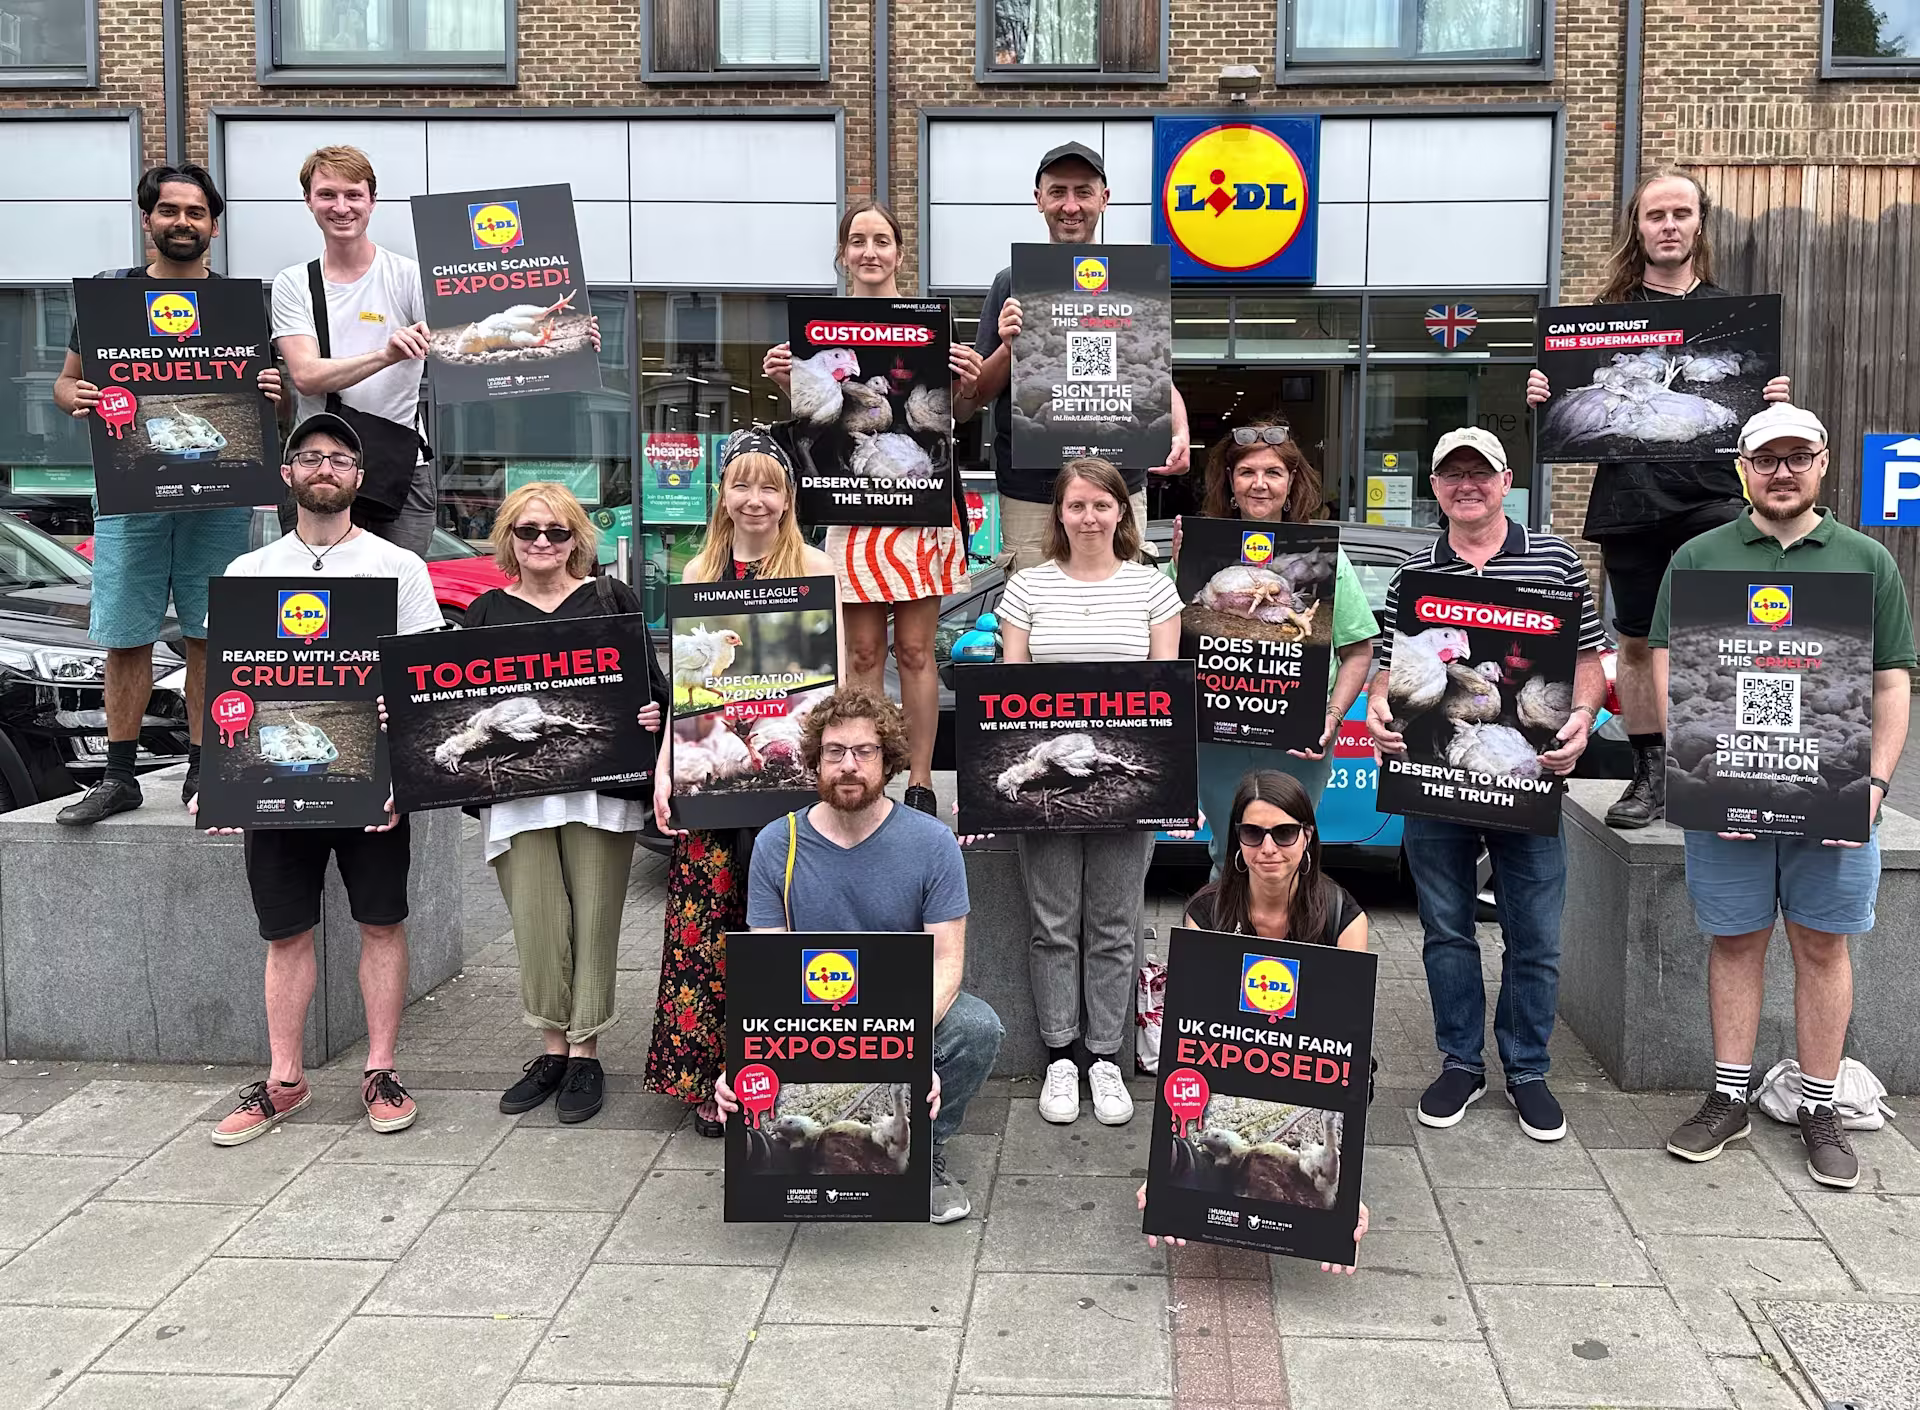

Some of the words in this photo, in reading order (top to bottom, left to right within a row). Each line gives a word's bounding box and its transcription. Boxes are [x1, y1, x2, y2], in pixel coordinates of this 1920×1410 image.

[432, 261, 497, 276] CHICKEN
[501, 255, 568, 270] SCANDAL
[436, 268, 570, 296] EXPOSED!
[1052, 304, 1094, 316] HELP
[1098, 304, 1132, 316] END
[1051, 318, 1078, 326] THIS
[1080, 317, 1132, 328] CRUELTY
[1548, 324, 1575, 334] CAN
[1578, 322, 1605, 333] YOU
[1608, 320, 1648, 332] TRUST
[811, 326, 929, 342] CUSTOMERS
[1548, 338, 1576, 348] THIS
[1580, 332, 1682, 346] SUPERMARKET?
[97, 348, 163, 359] REARED
[167, 347, 209, 358] WITH
[213, 345, 257, 358] CARE
[109, 360, 248, 382] CRUELTY
[1052, 384, 1092, 397] SIGN
[1098, 384, 1132, 397] THE
[1052, 398, 1132, 412] PETITION
[644, 444, 704, 460] cheapest
[802, 476, 868, 488] DESERVE
[872, 478, 892, 488] TO
[896, 478, 944, 490] KNOW
[1883, 462, 1920, 520] P
[832, 493, 862, 504] THE
[864, 494, 913, 505] TRUTH
[700, 590, 750, 601] HUMANE
[753, 587, 798, 598] LEAGUE
[1421, 602, 1554, 630] CUSTOMERS
[1200, 635, 1253, 654] DOES
[1258, 640, 1303, 658] THIS
[1719, 639, 1772, 654] HELP
[1778, 640, 1823, 656] END
[222, 651, 288, 662] REARED
[292, 650, 334, 661] WITH
[339, 650, 380, 662] CARE
[1718, 655, 1752, 666] THIS
[1756, 656, 1822, 669] CRUELTY
[408, 647, 622, 690] TOGETHER
[1198, 654, 1253, 673] LOOK
[1258, 658, 1302, 677] LIKE
[232, 666, 372, 686] CRUELTY
[705, 672, 804, 688] EXPECTATION
[410, 693, 430, 704] WE
[433, 690, 464, 702] HAVE
[465, 688, 488, 698] THE
[490, 684, 532, 696] POWER
[533, 681, 550, 691] TO
[551, 676, 596, 688] CHANGE
[598, 674, 624, 684] THIS
[722, 688, 788, 700] versus
[726, 704, 784, 716] REALITY
[979, 691, 1172, 718] TOGETHER
[1204, 693, 1230, 710] TO
[1236, 696, 1288, 715] YOU?
[980, 722, 997, 730] WE
[1000, 722, 1026, 730] HAVE
[1029, 721, 1048, 730] THE
[1050, 720, 1088, 730] POWER
[1090, 720, 1104, 728] TO
[1106, 719, 1148, 728] CHANGE
[1150, 718, 1172, 727] THIS
[1716, 734, 1768, 751] SIGN
[1775, 737, 1819, 753] THE
[1716, 750, 1818, 771] PETITION
[594, 774, 622, 782] HUMANE
[623, 770, 647, 779] LEAGUE
[1389, 760, 1464, 782] DESERVE
[1469, 771, 1492, 784] TO
[1496, 774, 1553, 794] KNOW
[1716, 770, 1818, 784] thl.link/LidlSellsSuffering
[1422, 782, 1454, 798] THE
[1458, 787, 1514, 807] TRUTH
[742, 1018, 769, 1032] UK
[774, 1018, 856, 1032] CHICKEN
[863, 1018, 914, 1032] FARM
[1178, 1018, 1204, 1036] UK
[1209, 1022, 1293, 1048] CHICKEN
[1298, 1036, 1352, 1056] FARM
[744, 1036, 914, 1060] EXPOSED!
[1178, 1038, 1350, 1086] EXPOSED!
[1208, 1214, 1232, 1222] LEAGUE
[1211, 1208, 1239, 1218] HUMANE
